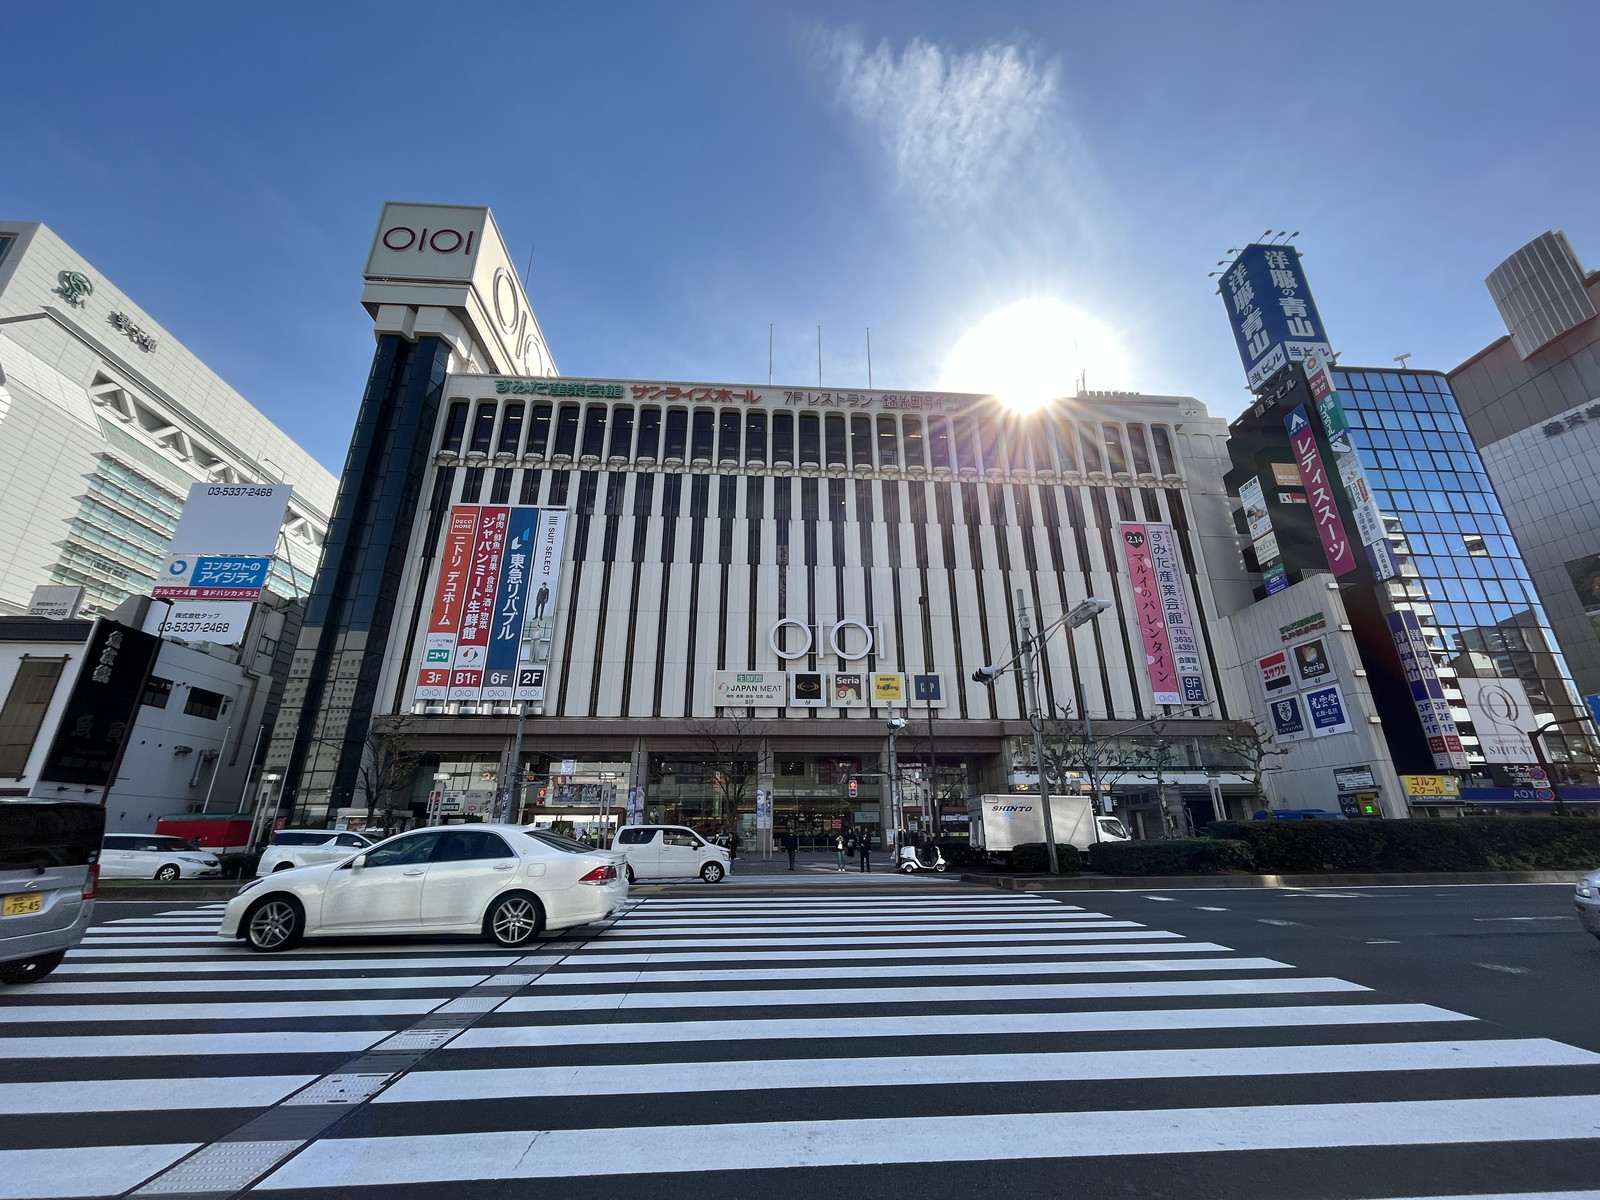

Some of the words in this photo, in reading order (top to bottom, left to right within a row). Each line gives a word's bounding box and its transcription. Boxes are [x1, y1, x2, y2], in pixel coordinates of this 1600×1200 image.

[1265, 250, 1315, 337] 洋服の青山
[1228, 262, 1270, 361] 洋服の青山
[494, 379, 624, 398] すみだ産業会館
[783, 391, 803, 405] 7F
[808, 392, 873, 408] レストラン
[207, 486, 273, 497] 03-5337-2468
[1297, 437, 1346, 562] レディススーツ
[547, 527, 556, 545] SUIT
[202, 561, 260, 572] コンタクトの
[542, 546, 553, 576] SELECT
[198, 572, 257, 585] アイシティ
[461, 516, 497, 640] ジャパンミート生鮮館
[1149, 530, 1184, 625] すみだ産業会館
[201, 588, 259, 598] ヨドバシカメラ上
[438, 571, 459, 626] デコホーム
[497, 553, 526, 641] 東急リバブル
[175, 612, 221, 620] 株式会社タップ
[1133, 552, 1169, 683] マルイのバレンタイン
[157, 622, 230, 634] 03-5337-2468
[428, 651, 448, 660] ニトリ
[1394, 631, 1420, 682] 洋服の青山
[1409, 629, 1436, 680] 洋服の青山
[1303, 661, 1325, 675] Seria
[426, 671, 442, 684] 3F
[455, 672, 479, 685] B1F
[490, 673, 508, 684] 6F
[522, 673, 541, 684] 2F
[837, 676, 860, 685] Seria
[1185, 678, 1200, 688] 9F
[920, 682, 935, 693] GP
[1188, 689, 1202, 700] 8F
[1311, 693, 1338, 710] 光雲堂
[1418, 701, 1431, 711] 3F
[1434, 701, 1447, 710] 3F
[1422, 714, 1435, 724] 2F
[1438, 713, 1450, 722] 2F
[1426, 725, 1440, 734] 1F
[1442, 723, 1455, 733] 1F
[1488, 746, 1533, 755] SHITAT
[1411, 777, 1437, 786] ゴルフ
[1411, 786, 1443, 794] スクール
